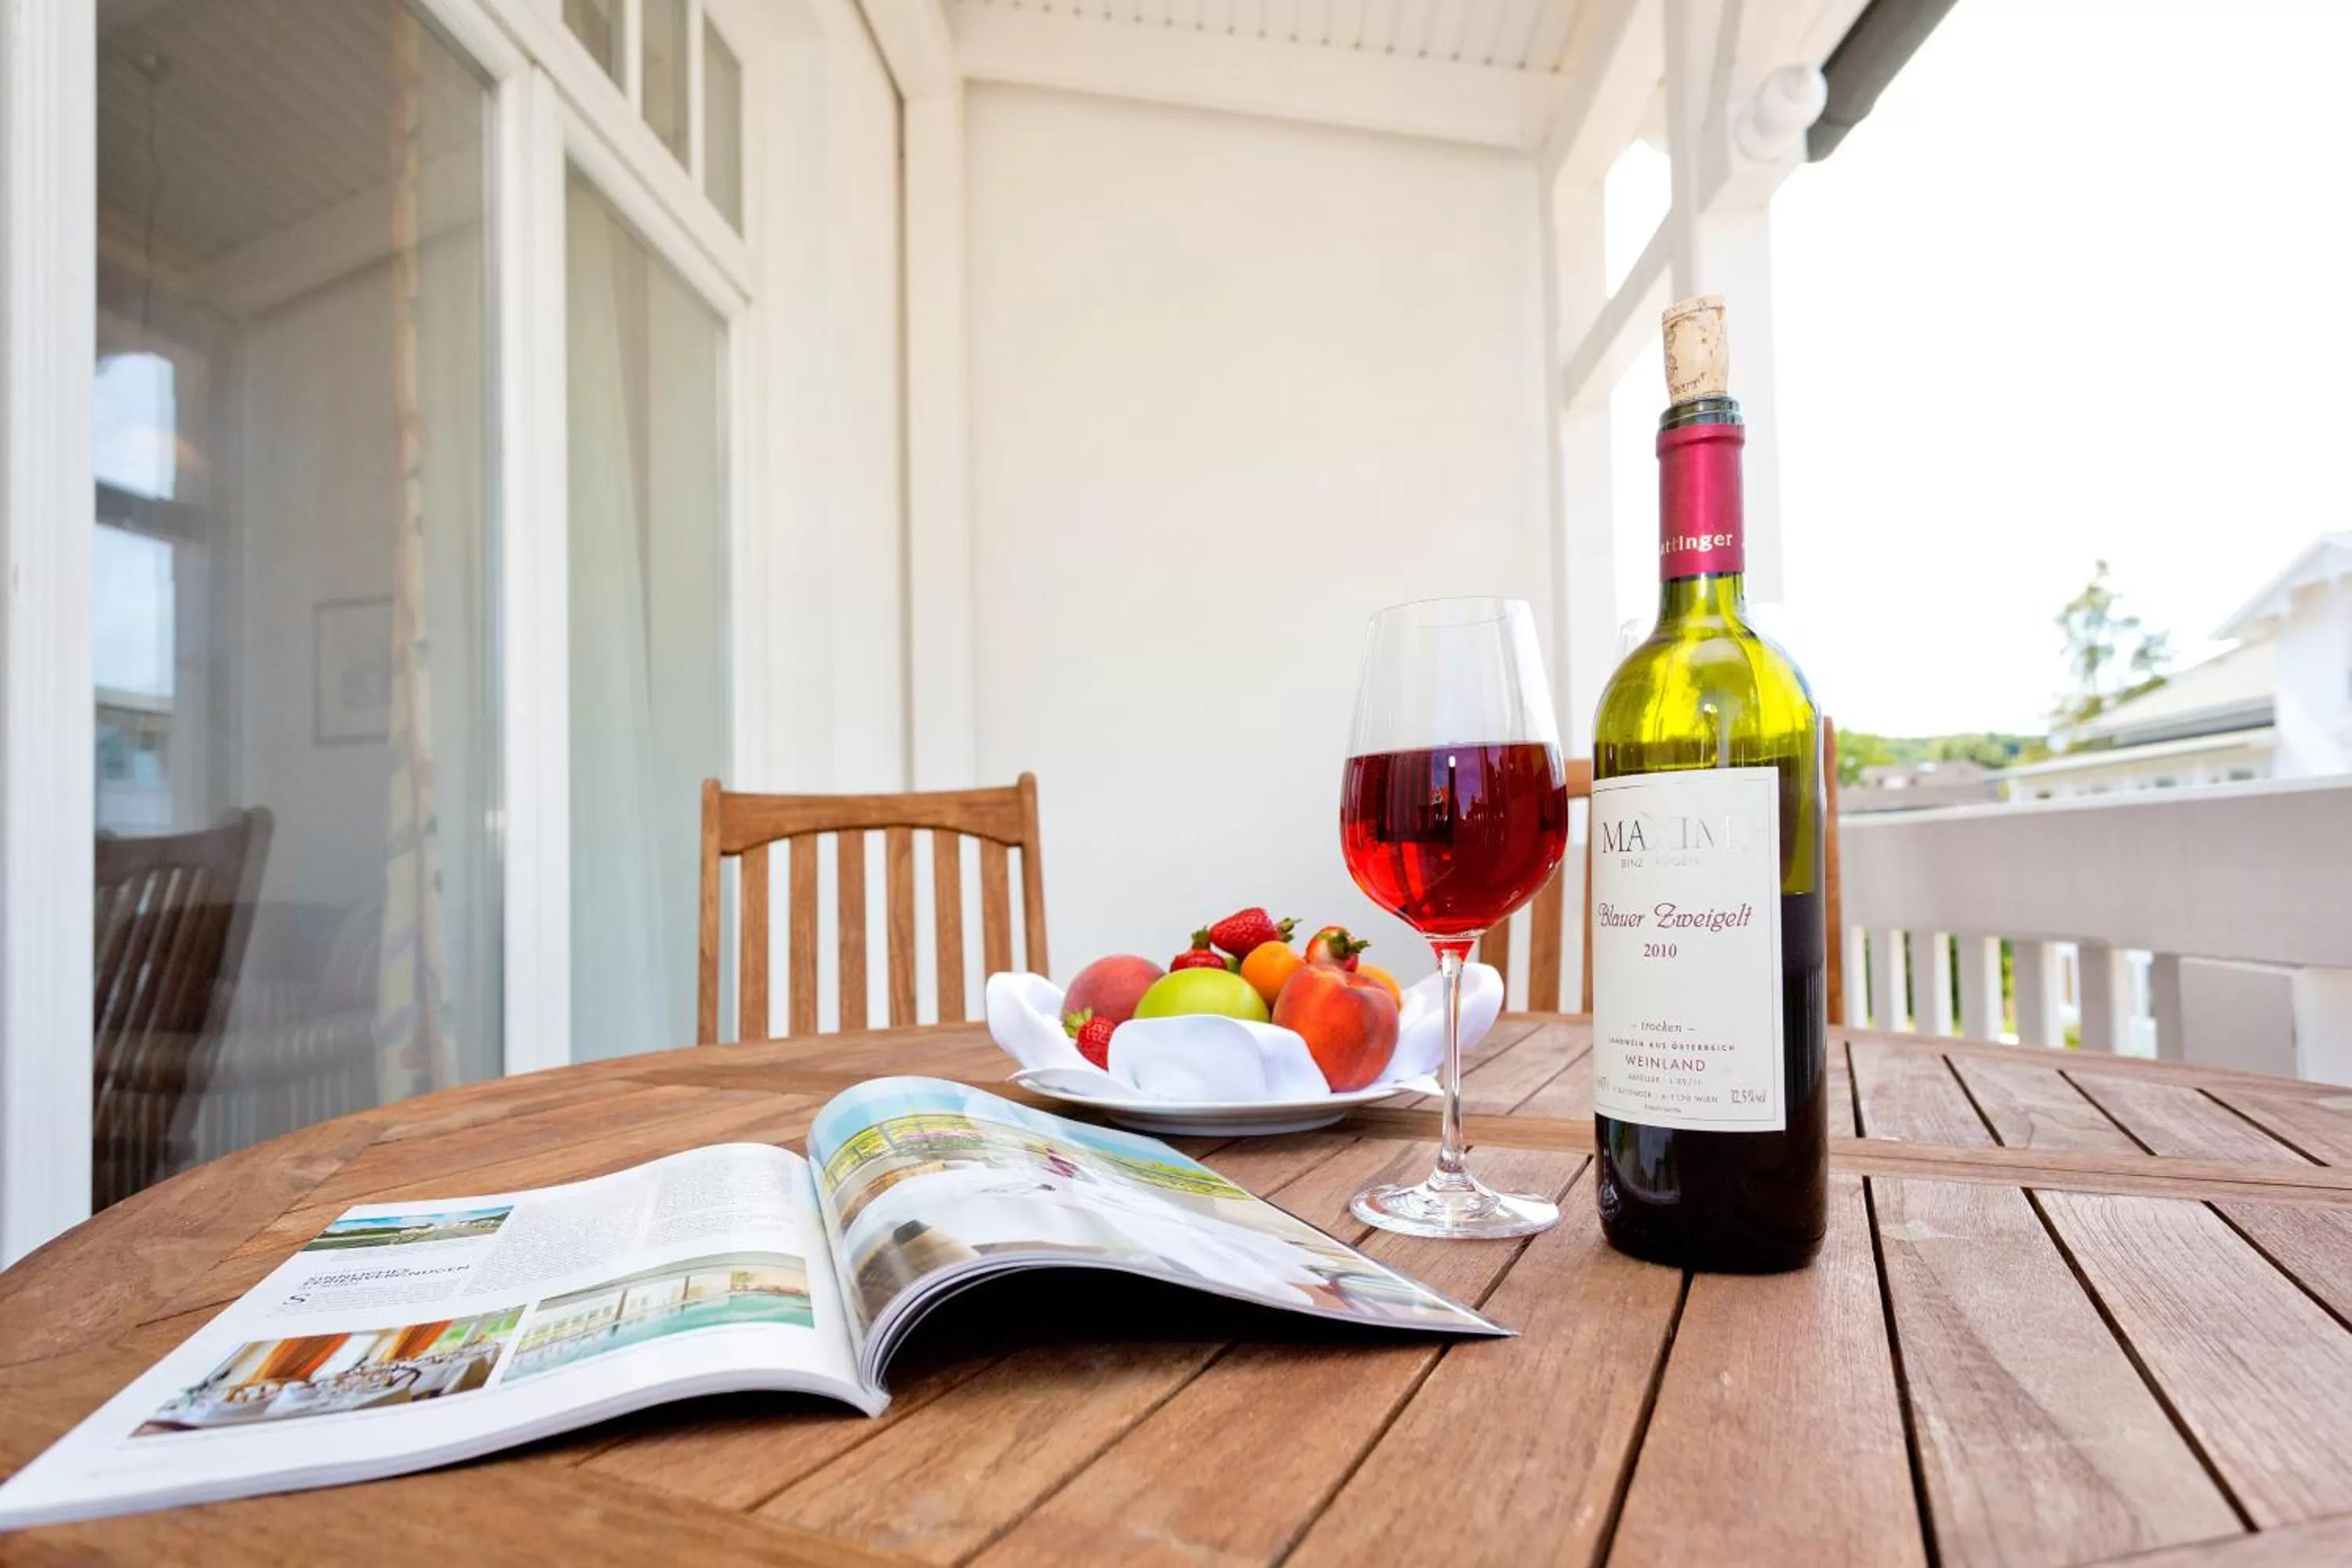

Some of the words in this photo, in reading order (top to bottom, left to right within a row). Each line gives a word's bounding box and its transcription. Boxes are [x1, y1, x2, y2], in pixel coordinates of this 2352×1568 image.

[1602, 815, 1733, 853] MAIM
[1599, 903, 1645, 927] Blauer
[1654, 903, 1751, 932] Zweigelt
[1643, 944, 1677, 958] 2010
[1641, 1021, 1681, 1033] trocken
[1649, 1041, 1667, 1050] AUS
[1671, 1041, 1735, 1052] ÖSTERREICH
[1625, 1054, 1706, 1072] WEINLAND
